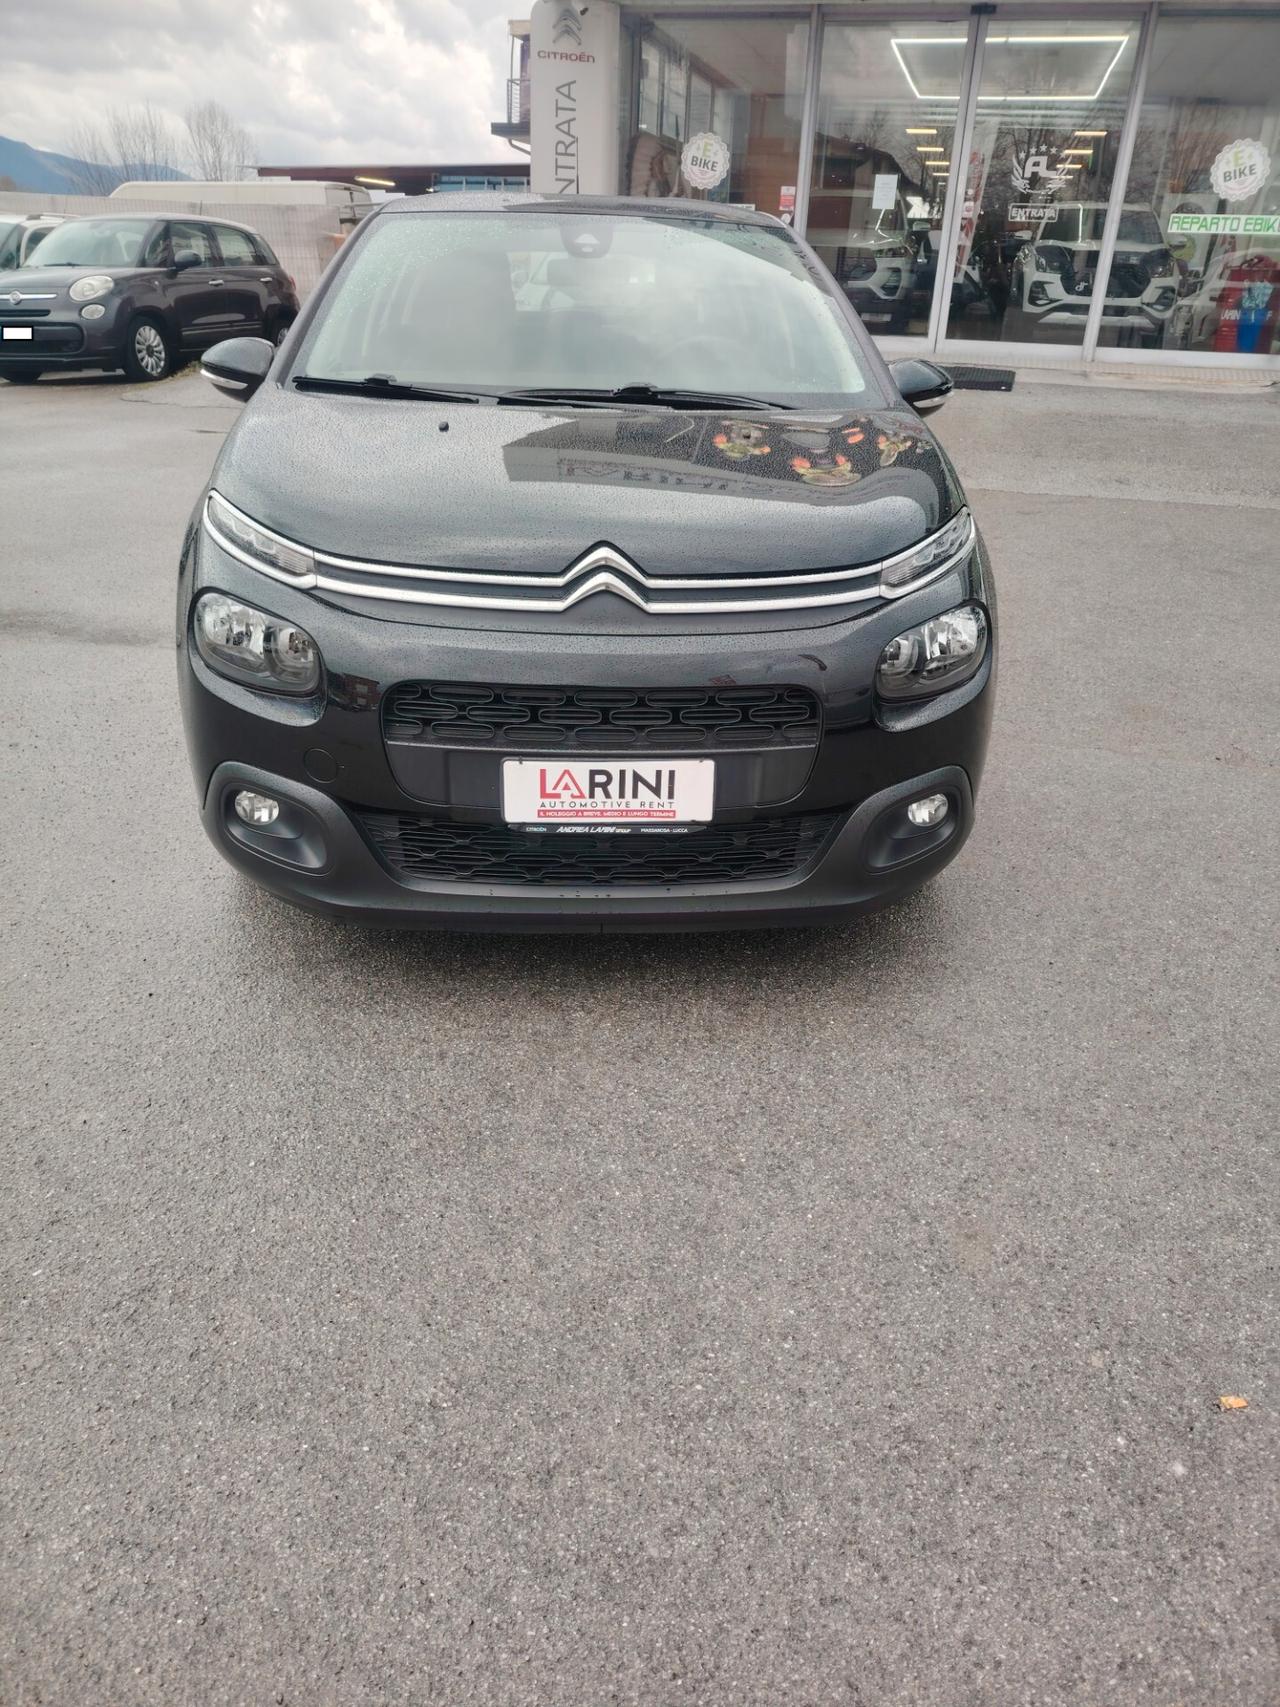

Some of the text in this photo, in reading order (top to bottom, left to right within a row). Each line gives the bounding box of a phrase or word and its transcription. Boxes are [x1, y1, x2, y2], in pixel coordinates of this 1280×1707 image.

[554, 80, 577, 195] NTRATA
[703, 140, 713, 158] E
[1232, 147, 1245, 168] E
[690, 155, 719, 172] BIKE
[1223, 163, 1257, 182] BIKE
[1011, 207, 1056, 218] ENTRATA
[1169, 215, 1241, 232] REPARTO
[539, 768, 676, 800] LARINI
[640, 801, 675, 809] RENT
